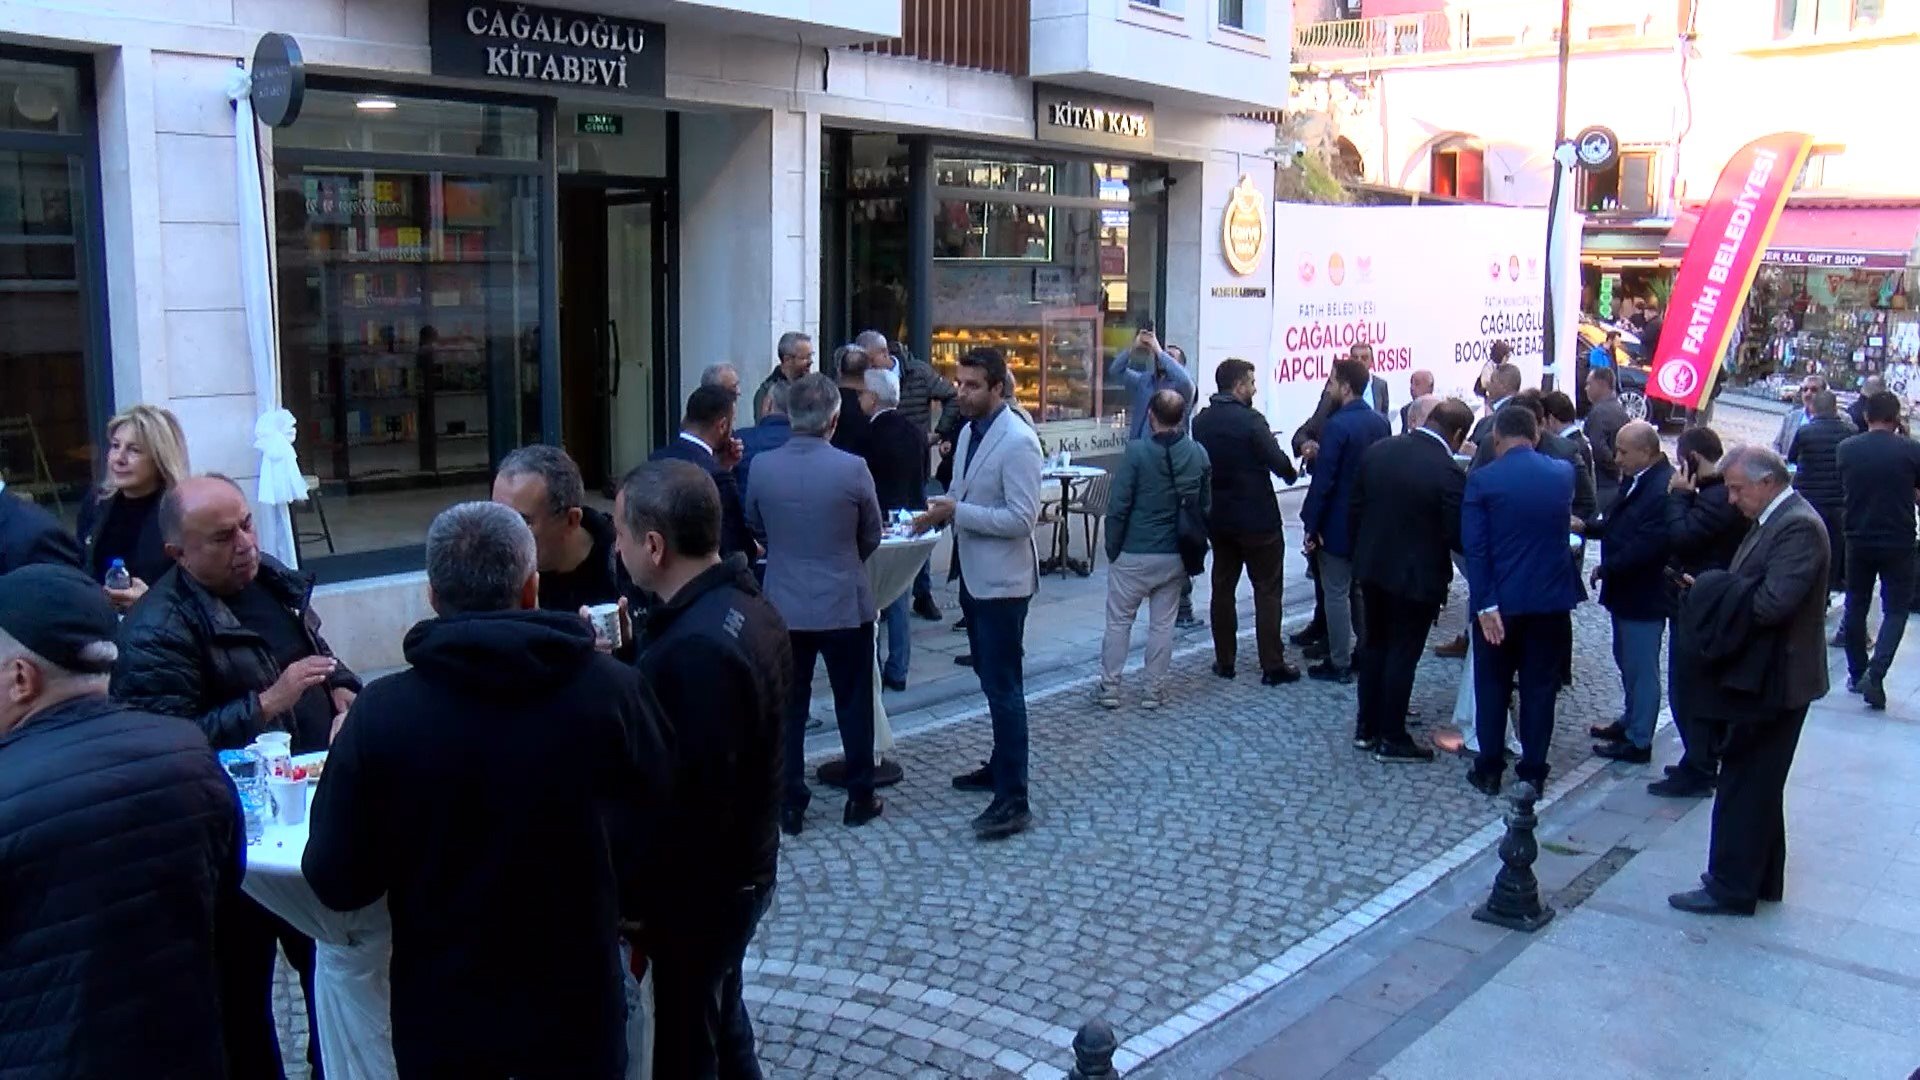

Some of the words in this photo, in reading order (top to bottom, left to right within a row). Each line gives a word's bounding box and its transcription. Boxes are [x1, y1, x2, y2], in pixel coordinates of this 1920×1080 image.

[467, 5, 645, 54] CAĞALOĞLU
[486, 43, 628, 89] KİTABEVİ
[1053, 101, 1104, 130] KİTAP
[1108, 111, 1147, 138] KAFE
[1681, 285, 1722, 355] FATİH
[1707, 148, 1779, 285] BELEDİYESİ
[1807, 253, 1833, 265] GIFT
[1835, 255, 1866, 266] SHOP
[1286, 319, 1386, 352] CAĞALOĞLU
[1060, 437, 1081, 452] Kek
